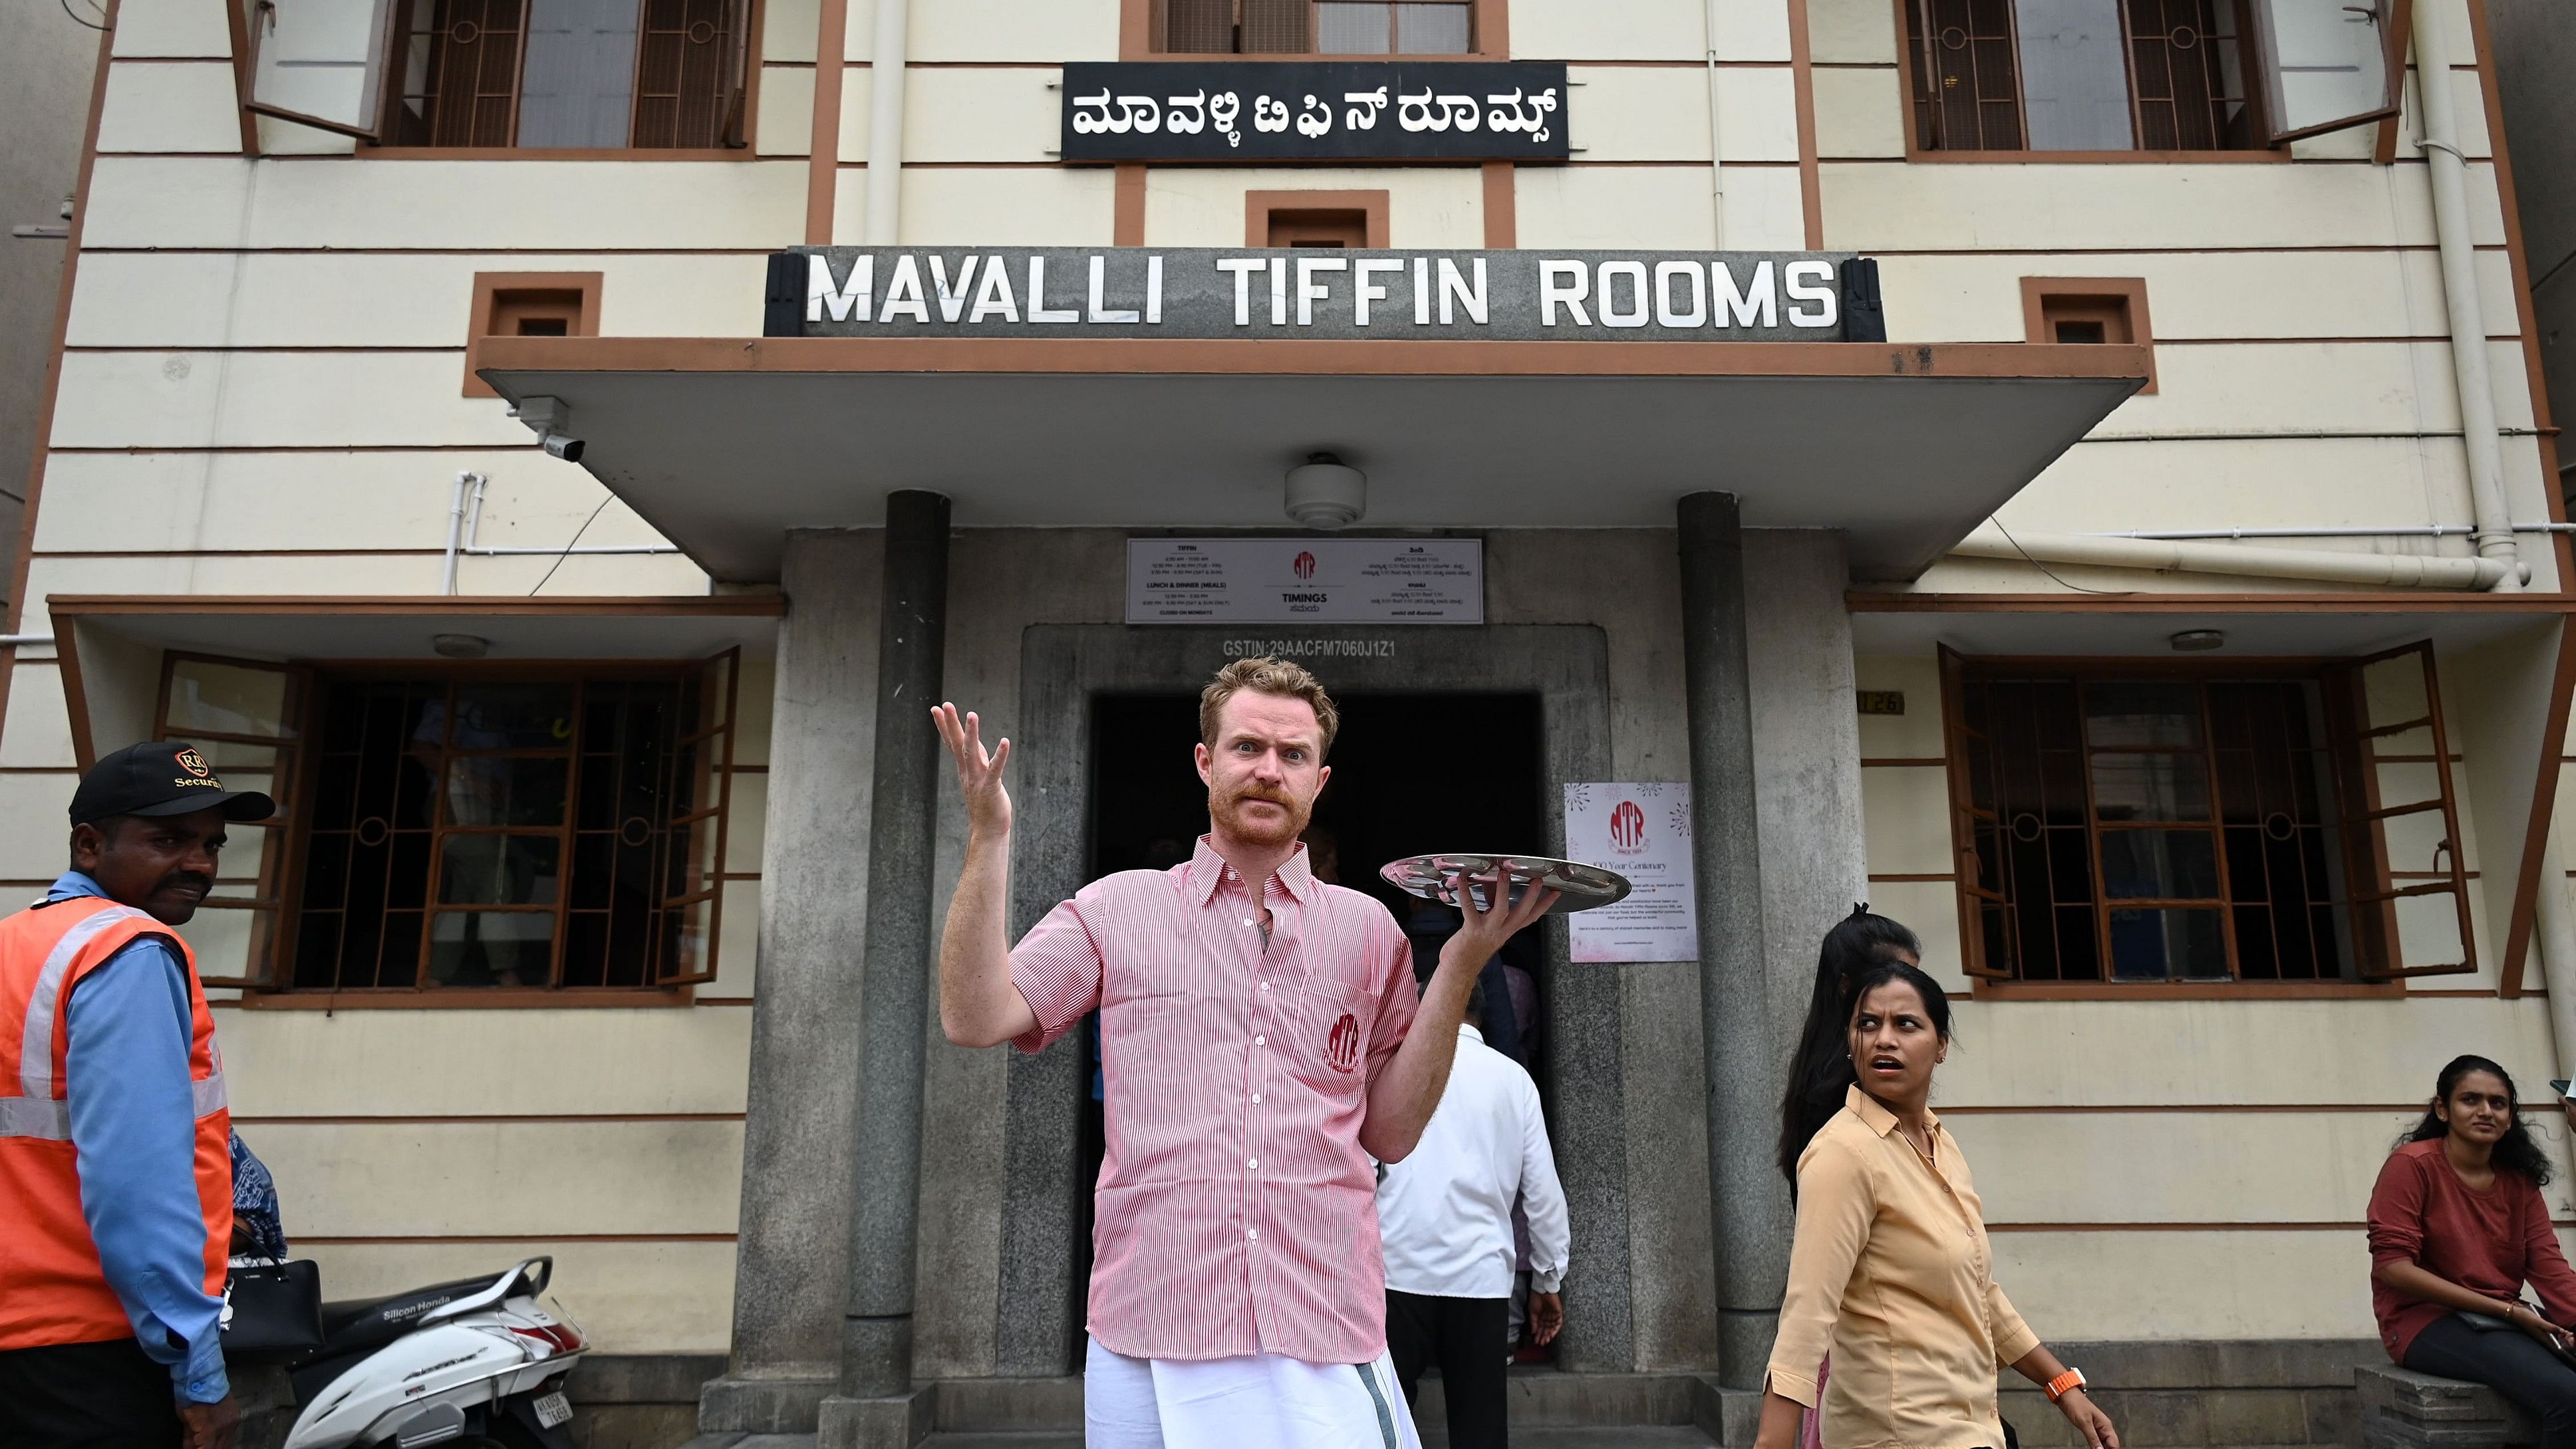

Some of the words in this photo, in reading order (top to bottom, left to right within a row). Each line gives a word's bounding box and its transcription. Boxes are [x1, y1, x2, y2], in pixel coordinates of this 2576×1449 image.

[1072, 87, 1241, 148] ಮಾವಳ್ಳಿ
[807, 255, 1162, 323] MAVALLI
[1216, 257, 1488, 326] TIFFIN
[1539, 259, 1838, 328] ROOMS
[1282, 593, 1328, 603] TIMINGS
[1223, 640, 1395, 657] GSTIN:29AACFM7060J1Z1
[181, 754, 207, 768] RR
[174, 777, 223, 792] Security
[1610, 801, 1645, 847] MTR
[1609, 861, 1627, 870] Year
[1628, 860, 1667, 872] Centenary
[1329, 1013, 1358, 1065] MTR
[383, 1305, 416, 1321] Silicon
[417, 1295, 451, 1313] Honda
